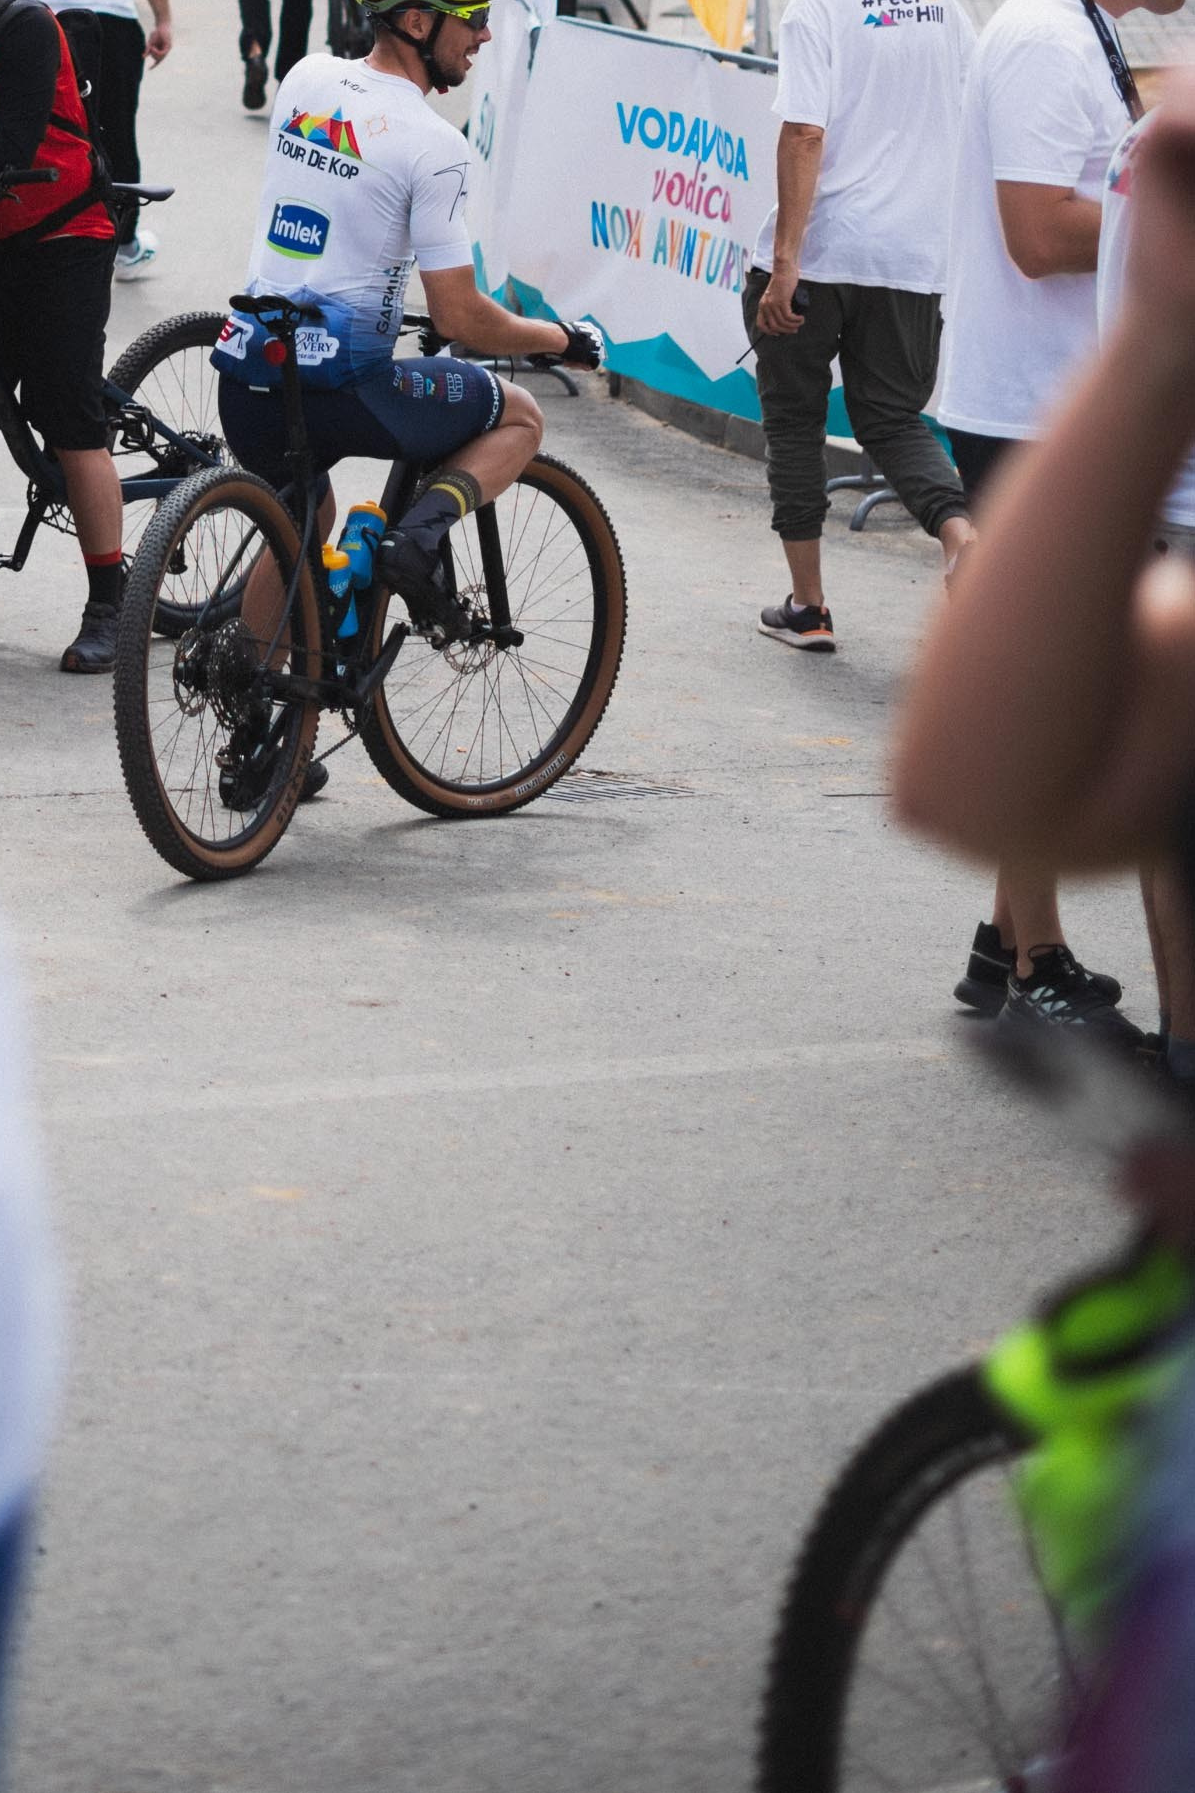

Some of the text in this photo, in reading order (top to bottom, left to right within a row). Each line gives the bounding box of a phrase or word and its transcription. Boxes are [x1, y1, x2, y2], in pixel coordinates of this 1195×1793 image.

[276, 133, 359, 180] TOUR DE KOP
[273, 209, 323, 247] imlek
